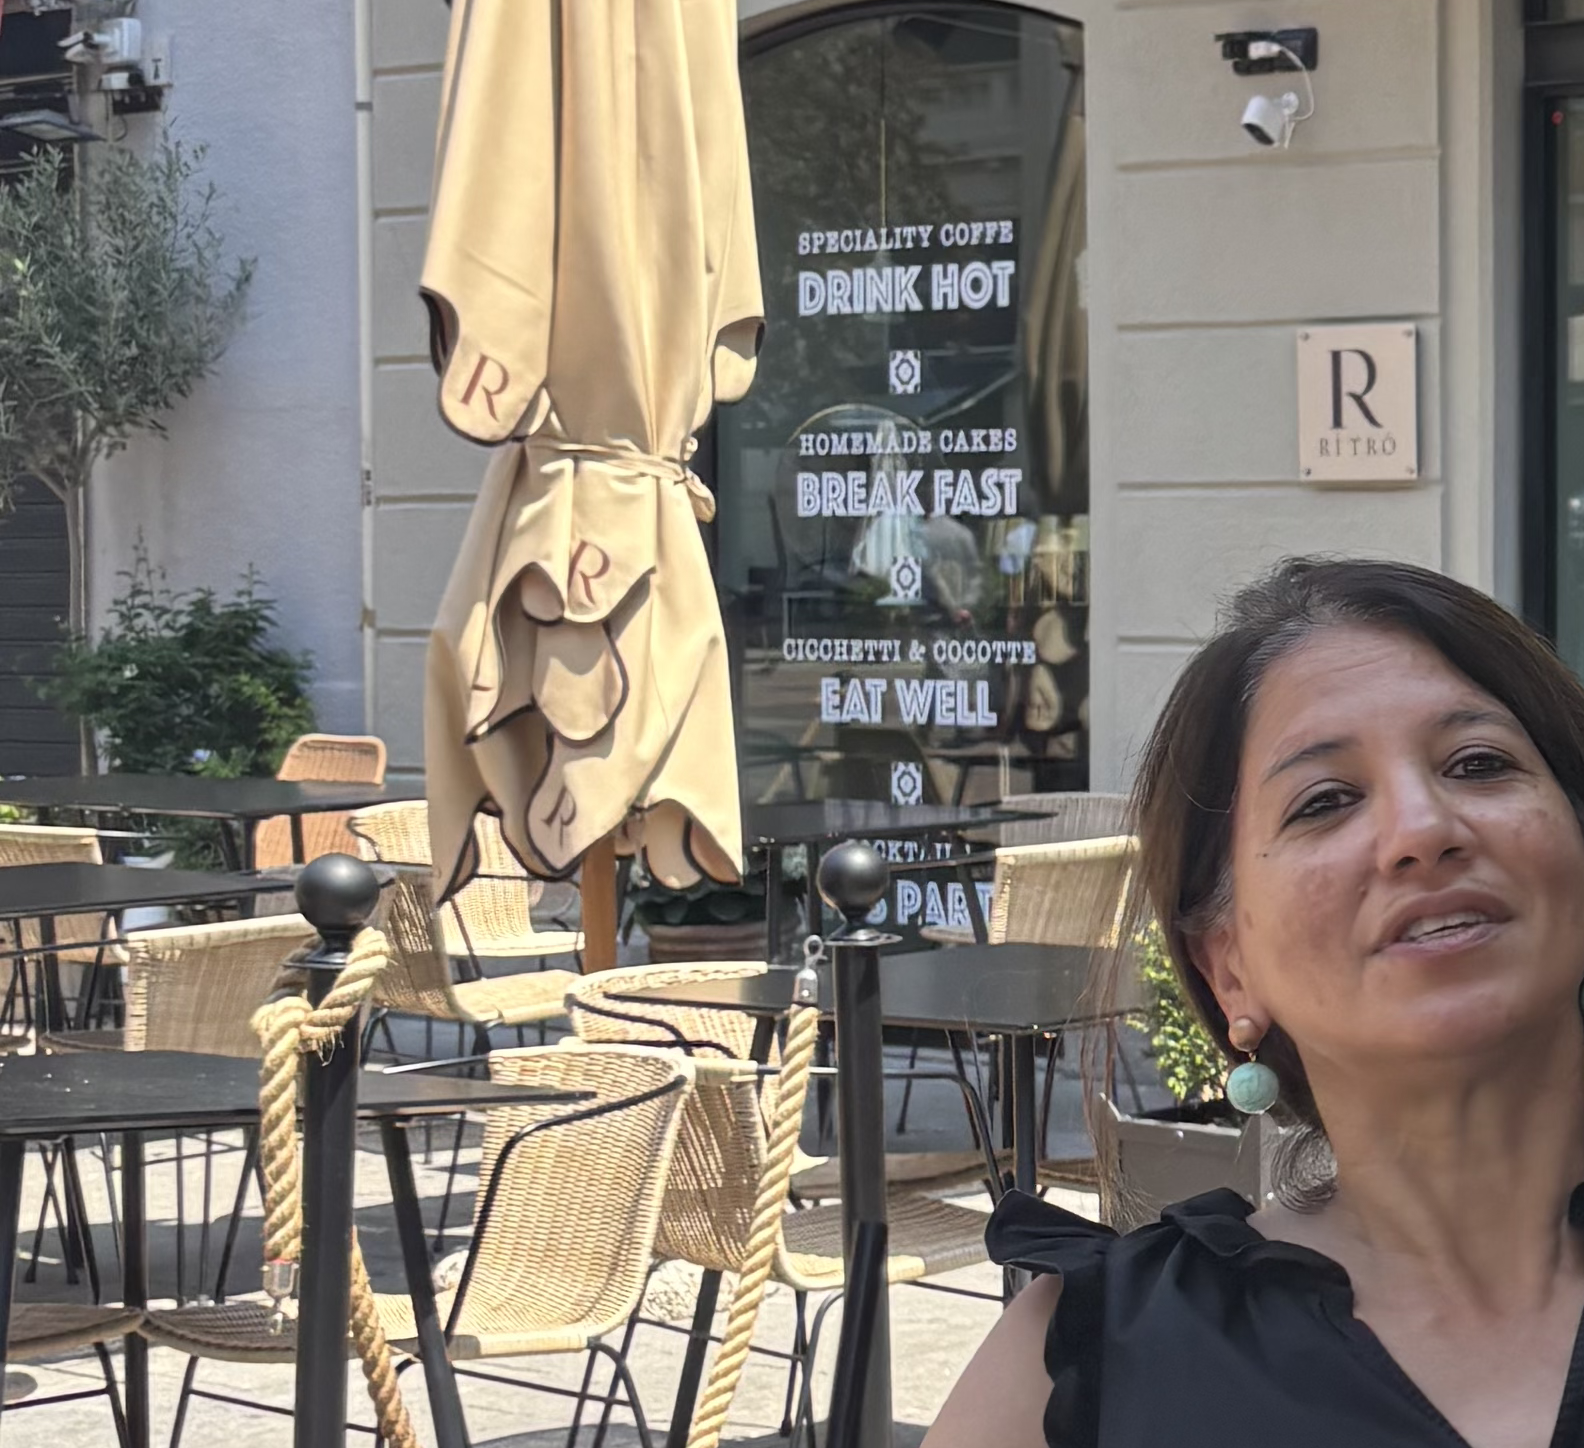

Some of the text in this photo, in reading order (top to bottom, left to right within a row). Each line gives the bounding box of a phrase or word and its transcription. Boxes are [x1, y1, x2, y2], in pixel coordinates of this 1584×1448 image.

[798, 220, 1014, 255] SPECIALITY COFFE
[798, 260, 1015, 317] DRINK HOT
[460, 352, 511, 422] R
[1328, 348, 1384, 430] R
[799, 428, 1017, 456] HOMEMADE CAKES
[796, 467, 1022, 517] BREAK FAST
[567, 539, 611, 609] R
[783, 638, 1037, 665] CICCHETTI & COCOTTE
[820, 676, 998, 727] EAT WELL
